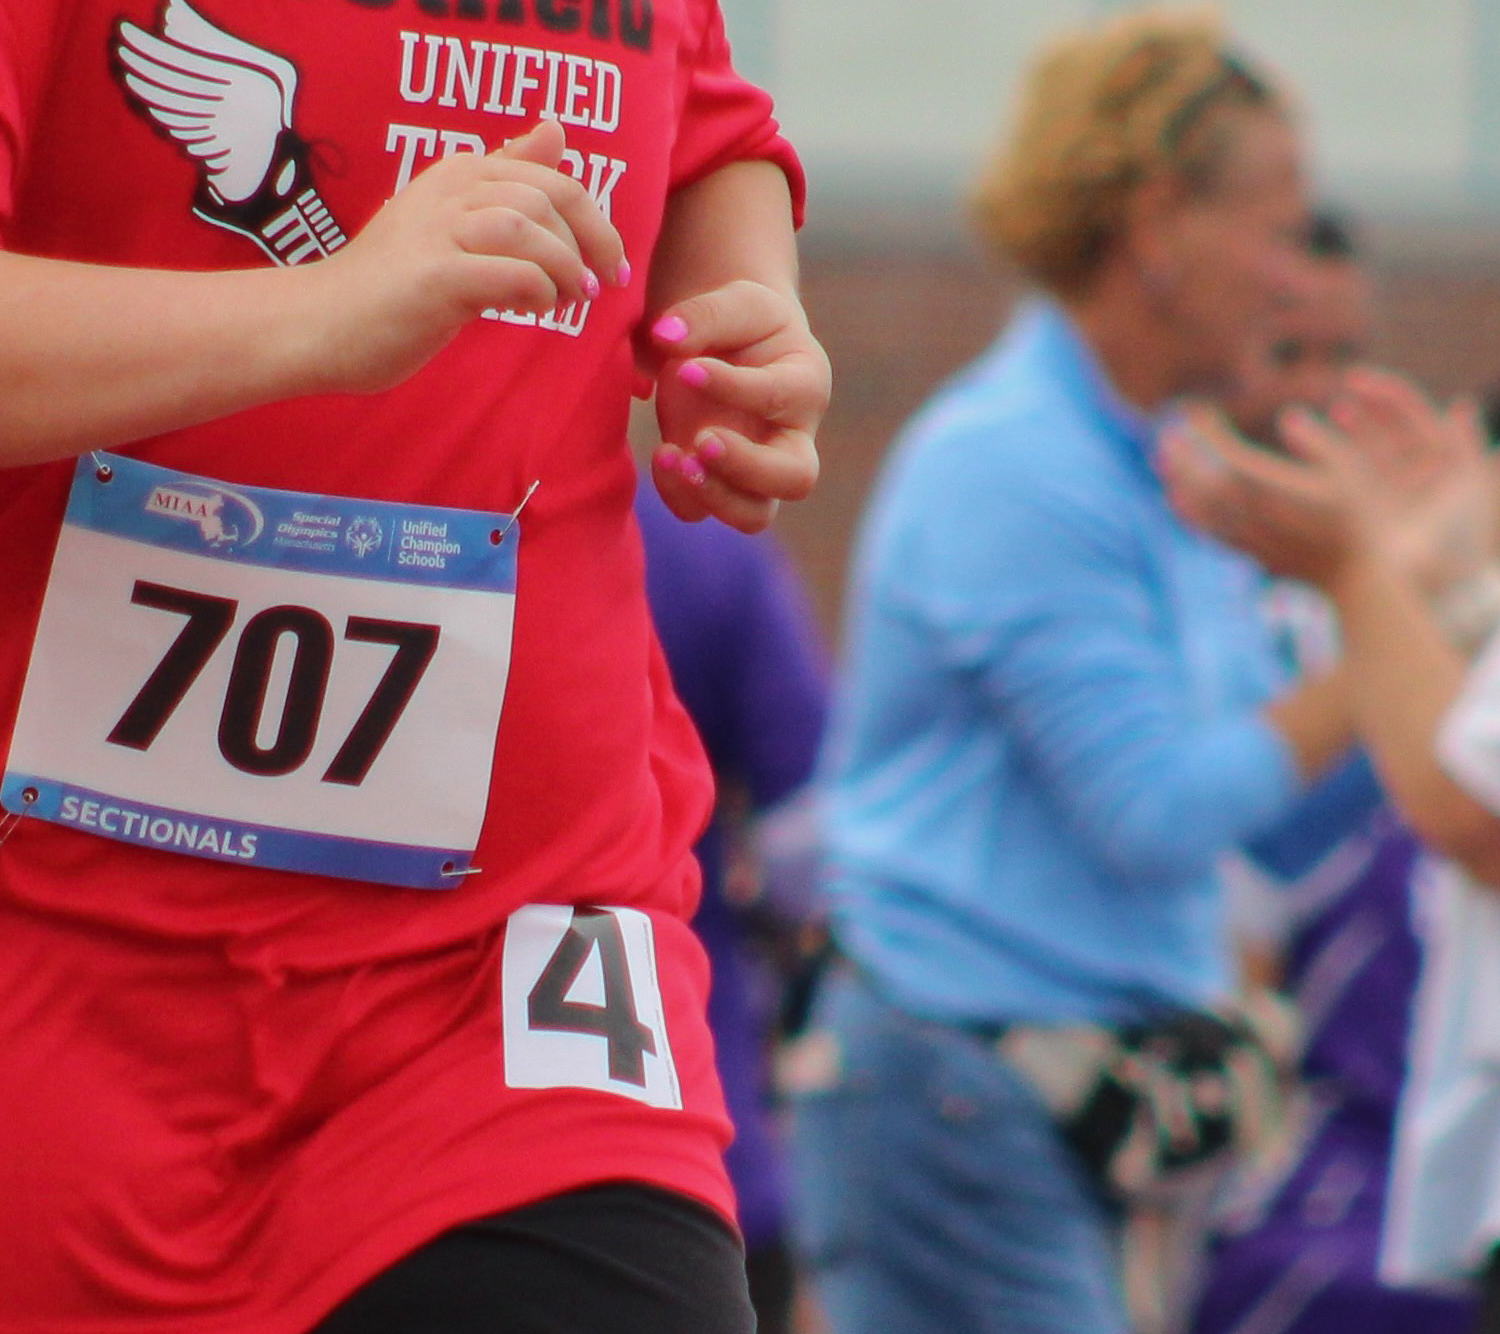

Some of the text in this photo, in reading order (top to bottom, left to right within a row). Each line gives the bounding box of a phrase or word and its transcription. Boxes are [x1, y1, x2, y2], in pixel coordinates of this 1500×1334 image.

[399, 30, 623, 133] UNIFIED
[153, 492, 208, 518] MIAA
[278, 523, 339, 539] Olympics
[293, 512, 342, 527] Special
[402, 520, 448, 538] Unified
[400, 535, 461, 555] Champion
[397, 551, 447, 569] Schools
[105, 579, 442, 787] 707
[60, 795, 259, 859] SECTIONALS
[526, 905, 658, 1090] 4
